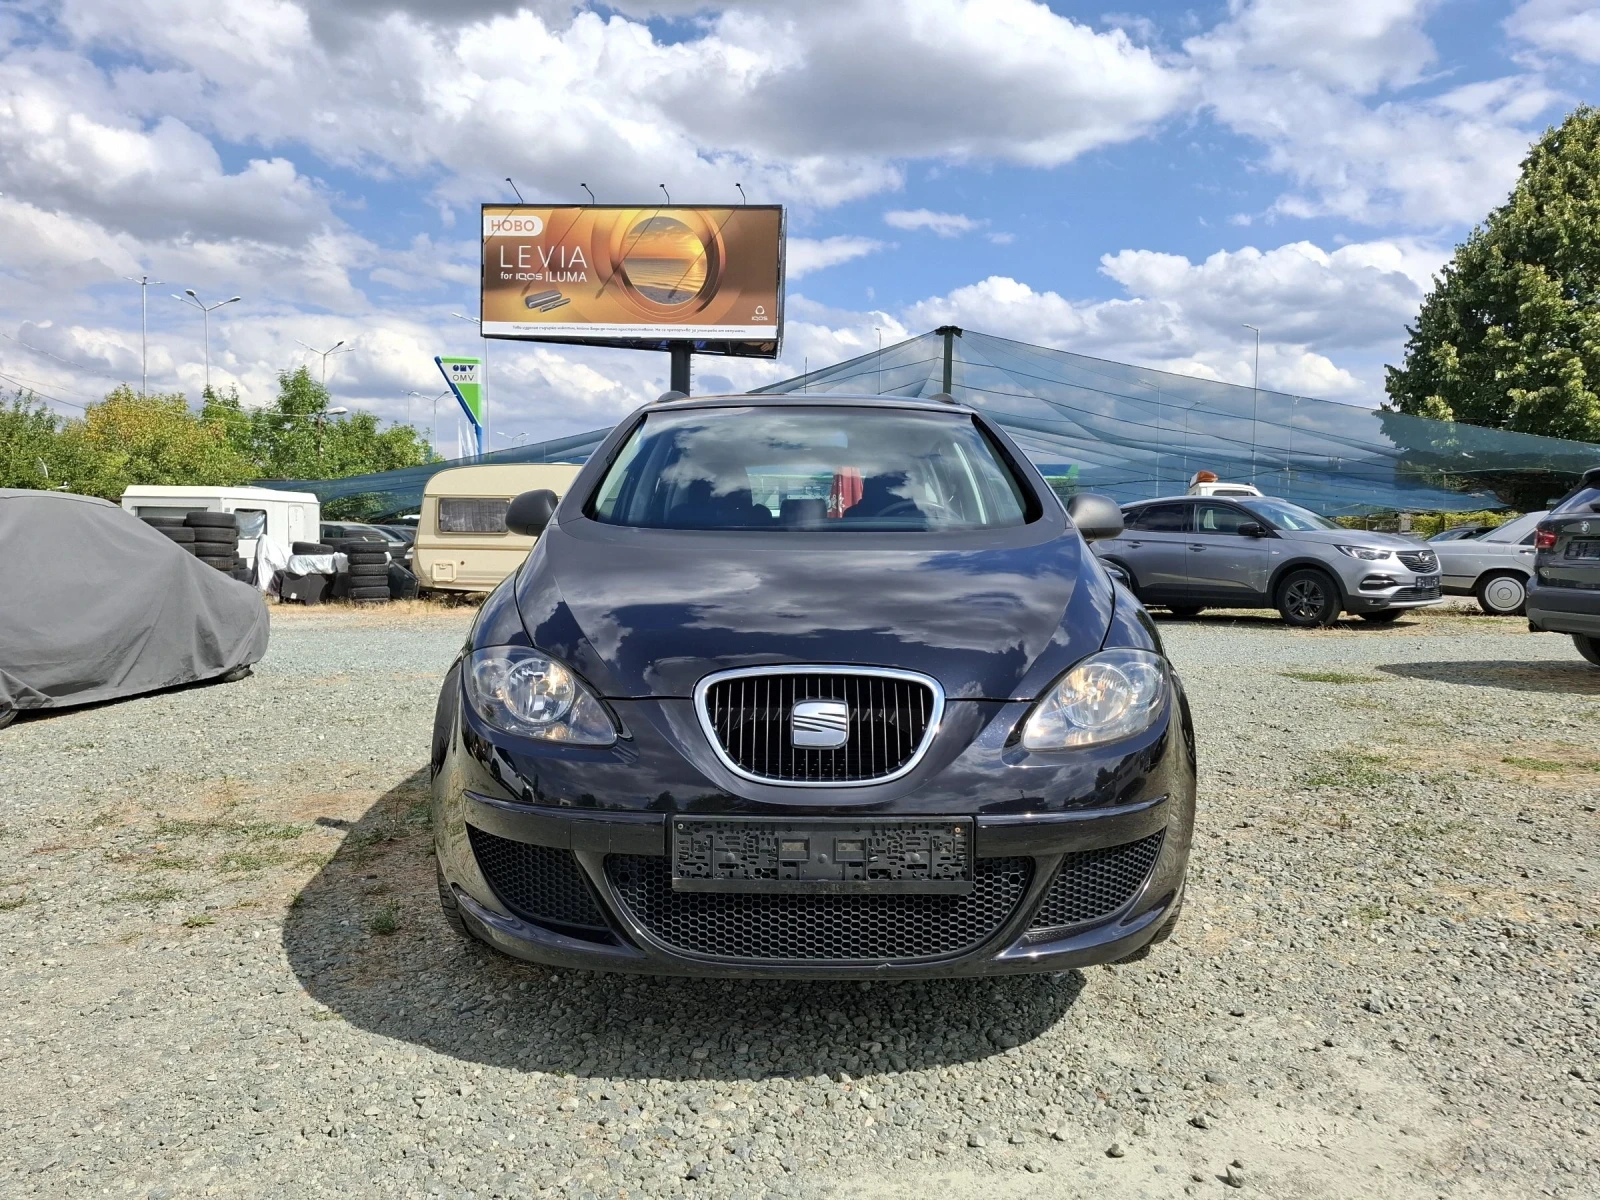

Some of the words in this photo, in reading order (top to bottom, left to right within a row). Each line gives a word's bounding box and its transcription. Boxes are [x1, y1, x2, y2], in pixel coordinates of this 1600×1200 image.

[500, 244, 588, 269] LEVIA
[500, 271, 513, 280] for
[515, 272, 543, 281] IQOS
[545, 271, 588, 283] ILUMA
